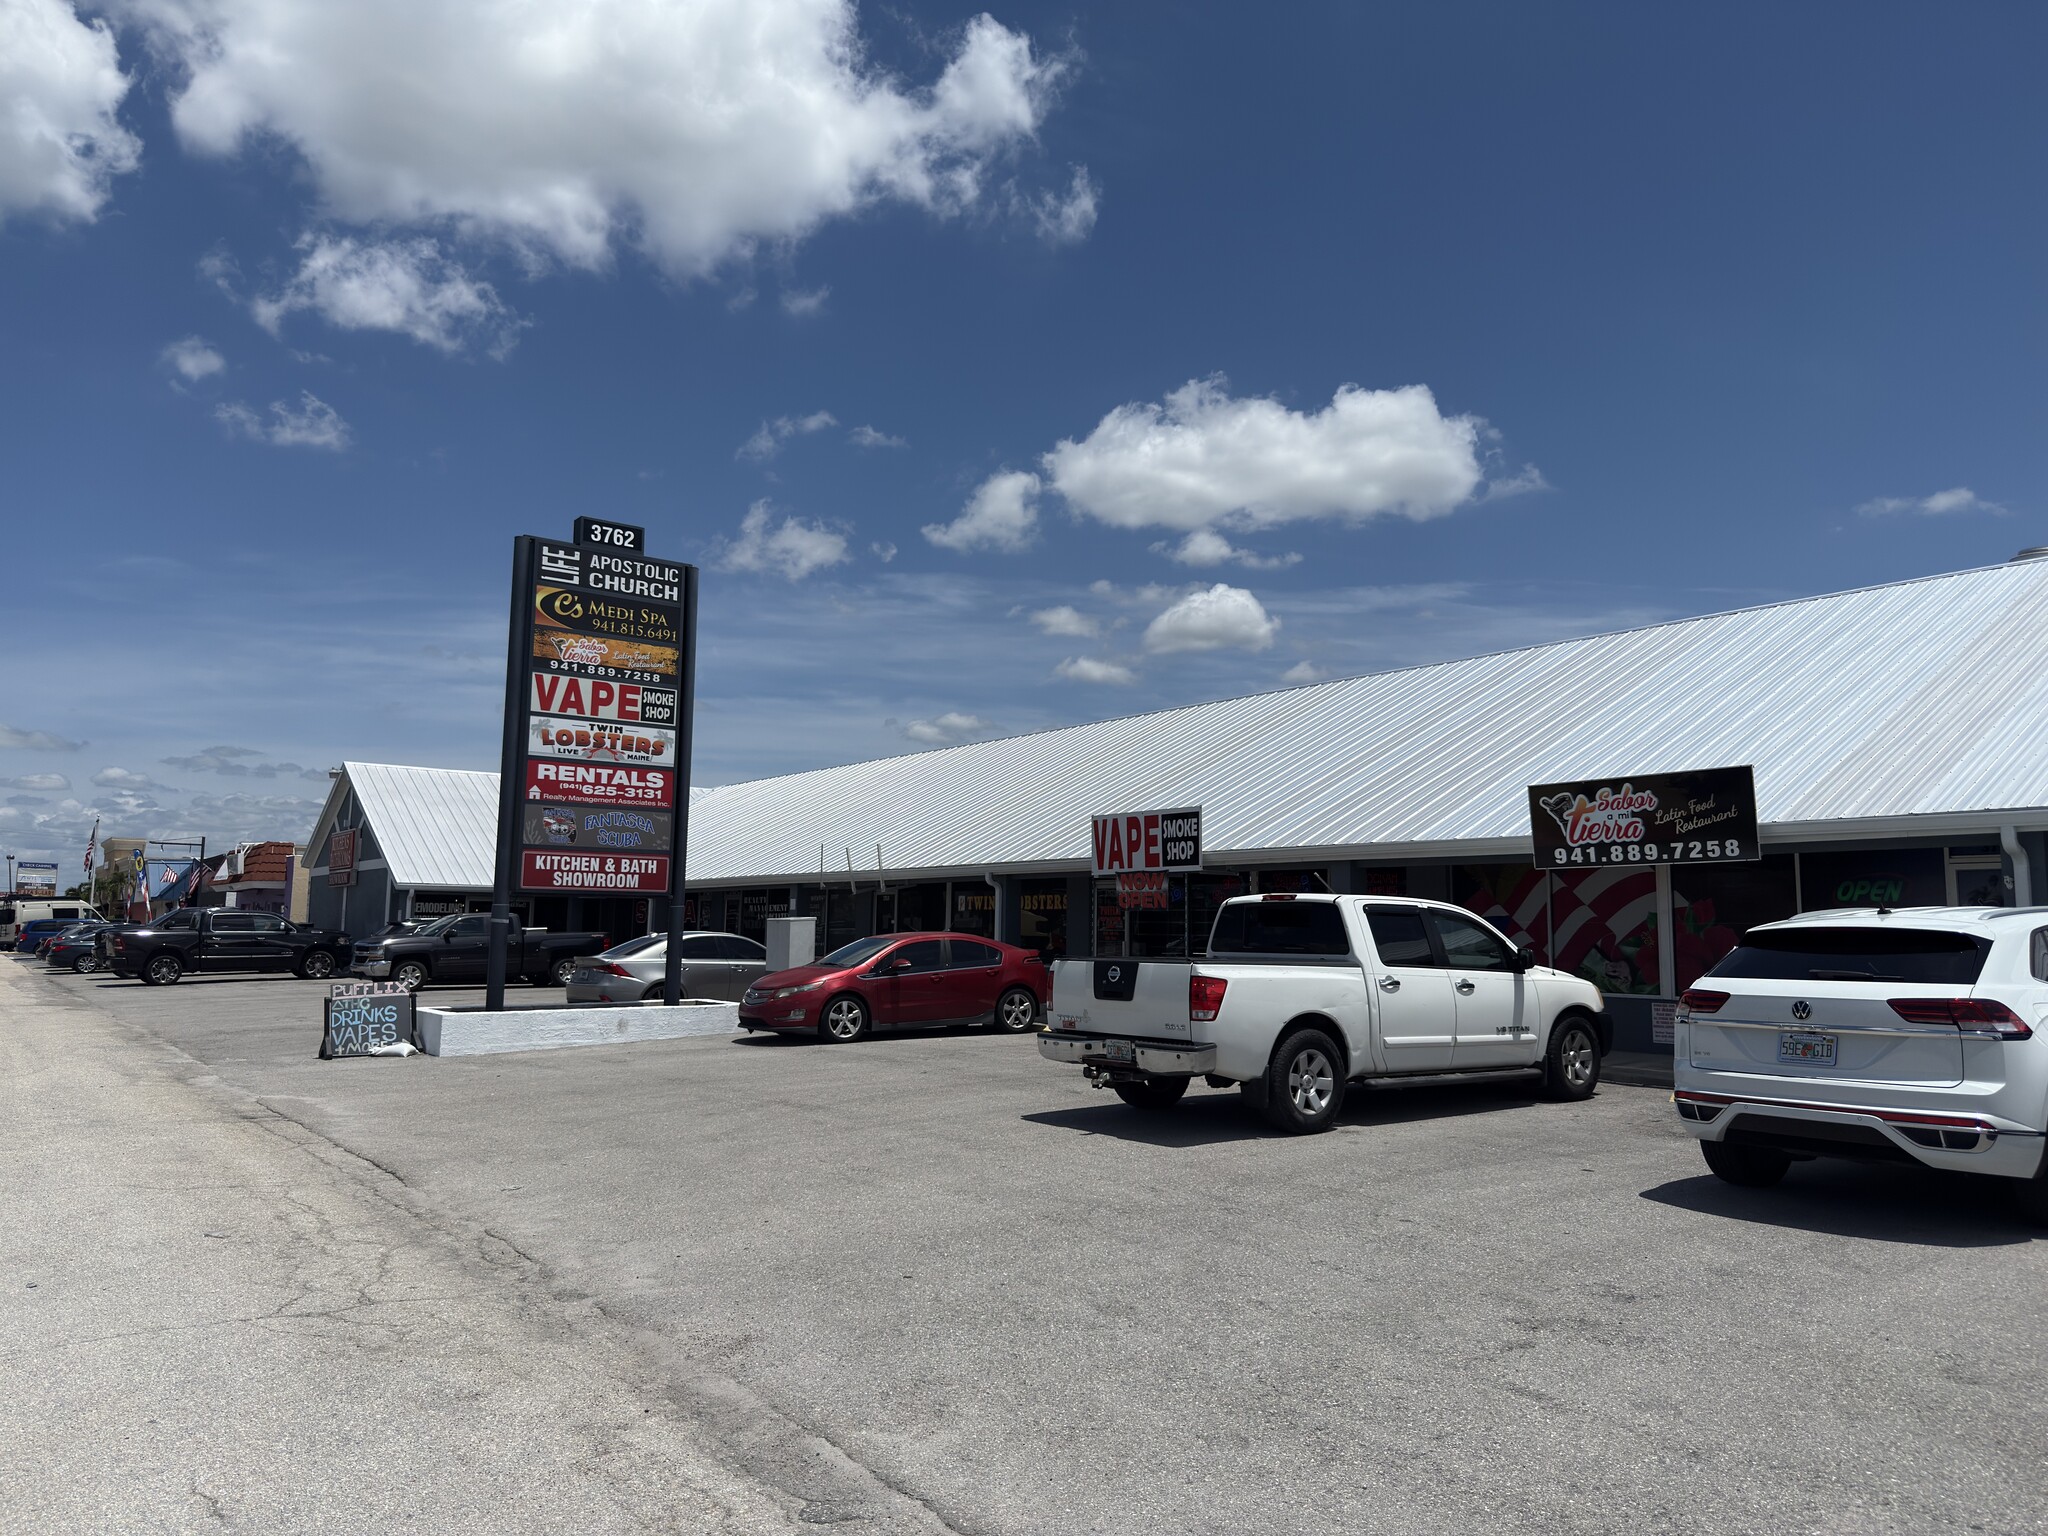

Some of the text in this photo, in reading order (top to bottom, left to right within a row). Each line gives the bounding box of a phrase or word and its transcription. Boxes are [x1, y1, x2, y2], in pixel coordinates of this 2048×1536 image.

[590, 524, 635, 548] 3762
[589, 554, 679, 583] APOSTOLIC
[589, 572, 678, 601] CHURCH
[592, 619, 677, 642] 941.815.6491
[579, 639, 608, 654] Sabor
[550, 660, 661, 683] 941.889.7258
[534, 673, 641, 721] VAPE
[643, 690, 674, 706] SMOKE
[645, 705, 671, 720] SHOP
[588, 723, 624, 734] TWIN
[541, 728, 666, 757] LOBSTERS
[557, 747, 579, 755] LIVE
[627, 753, 650, 762] MAINE
[537, 763, 665, 788] RENTALS
[543, 793, 566, 802] Realty
[568, 794, 617, 805] Management
[618, 798, 656, 807] Associates
[1597, 785, 1657, 812] Sabor
[1654, 793, 1717, 825] Latin Food
[1163, 817, 1198, 839] SMOKE
[1674, 805, 1739, 835] Restaurant
[598, 829, 642, 847] SCUBA
[1093, 814, 1160, 871] VAPE
[1166, 841, 1194, 861] SHOP
[1554, 839, 1741, 865] 941.889.7258
[535, 855, 657, 874] KITCHEN & BATH
[553, 871, 639, 888] SHOWROOM
[1118, 872, 1165, 891] NOW
[1118, 892, 1167, 910] OPEN
[1836, 879, 1904, 903] OPEN
[416, 902, 463, 914] EMODELING
[967, 895, 995, 911] TWIN
[332, 981, 410, 997] PUFFLIX
[332, 1005, 398, 1028] DRINKS
[332, 1023, 397, 1046] VAPES
